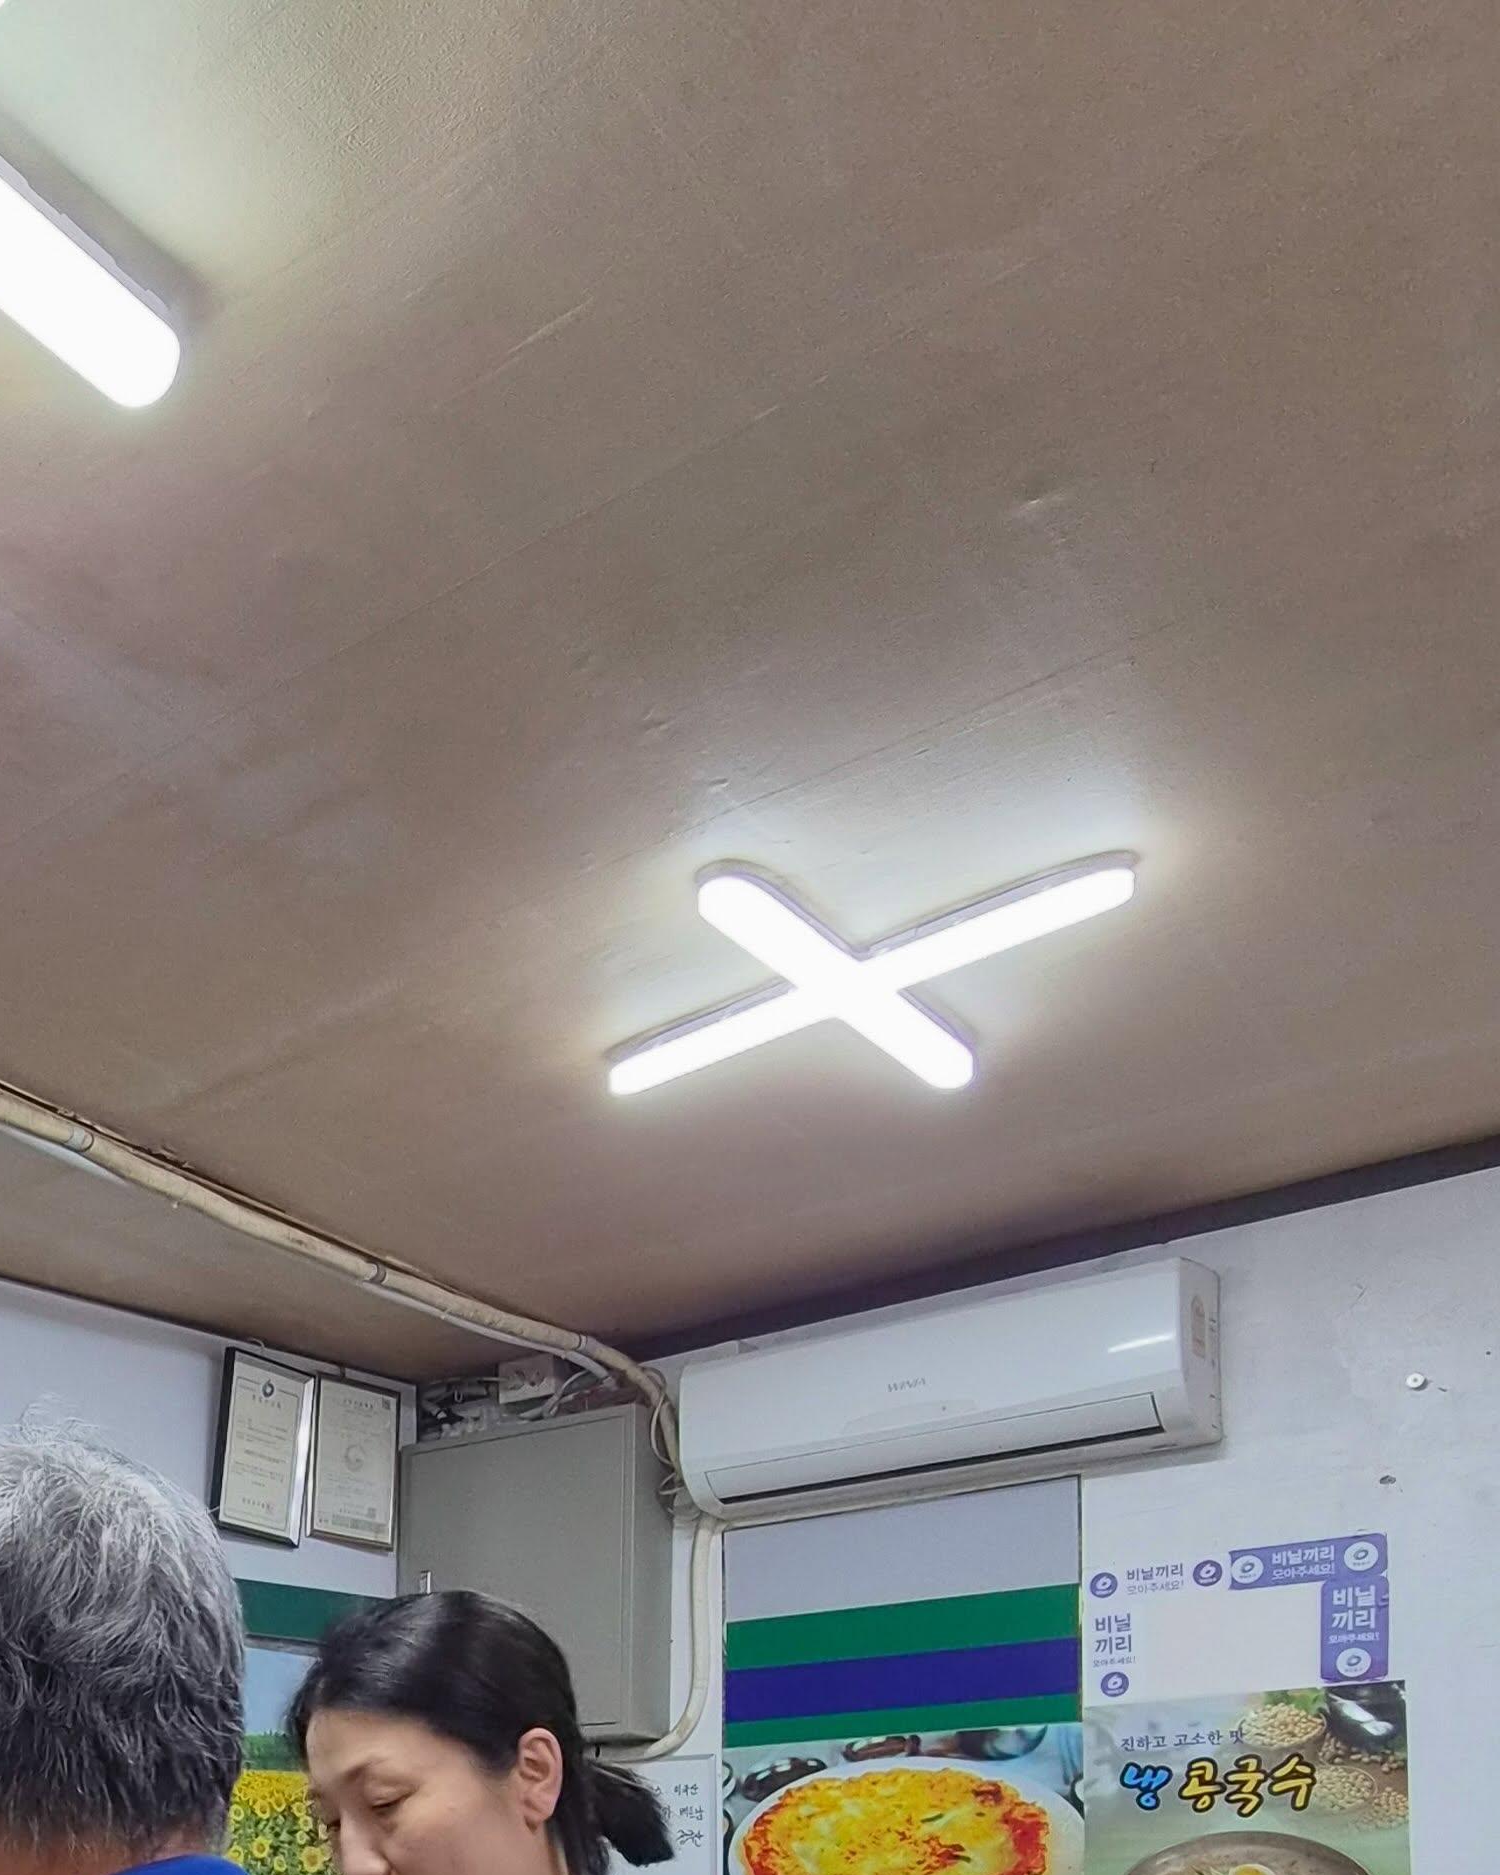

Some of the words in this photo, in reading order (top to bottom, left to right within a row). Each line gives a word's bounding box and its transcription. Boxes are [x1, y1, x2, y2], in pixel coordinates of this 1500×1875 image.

[1271, 1545, 1335, 1567] 비닐끼리
[1126, 1563, 1184, 1582] 비닐끼리
[1271, 1564, 1336, 1581] 모아주세요!
[1127, 1580, 1185, 1596] 모아주세요!
[1332, 1585, 1376, 1608] 비닐
[1094, 1612, 1132, 1634] 비닐
[1331, 1608, 1376, 1631] 끼리
[1094, 1634, 1133, 1655] 끼리
[1120, 1735, 1166, 1752] 진하고
[1173, 1730, 1223, 1748] 고소한
[1229, 1728, 1246, 1745] 맛
[1120, 1761, 1173, 1811] 냉
[1178, 1752, 1317, 1818] 콩국수
